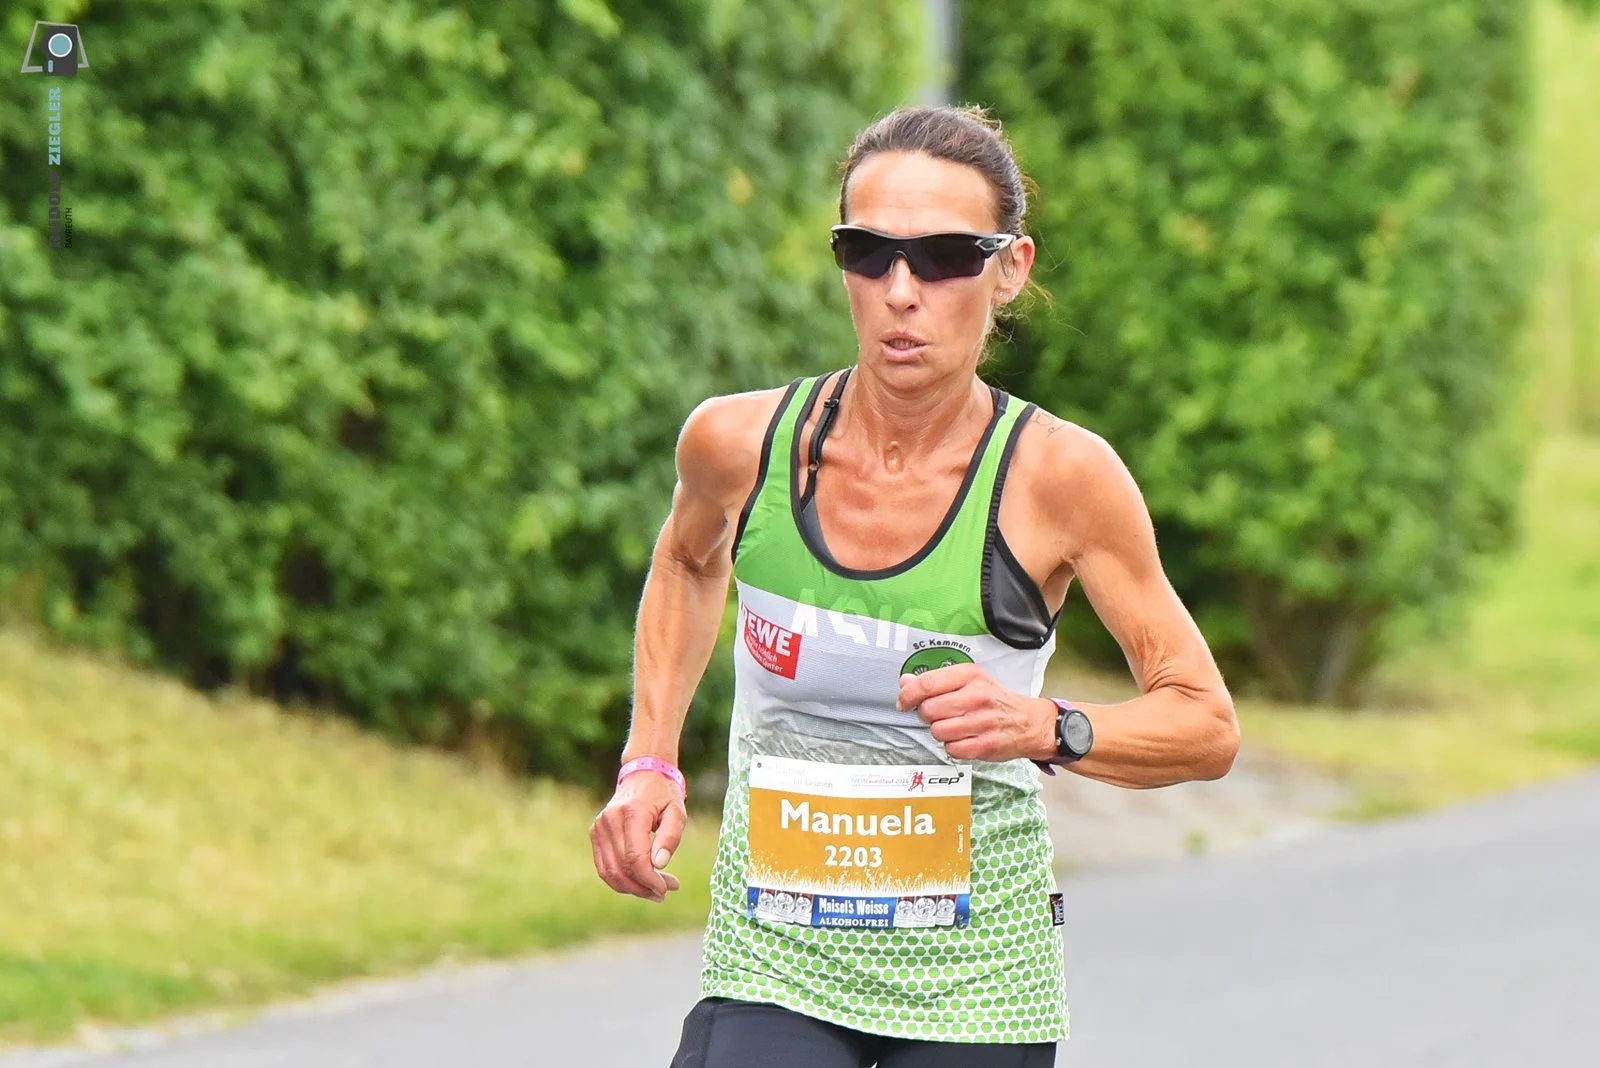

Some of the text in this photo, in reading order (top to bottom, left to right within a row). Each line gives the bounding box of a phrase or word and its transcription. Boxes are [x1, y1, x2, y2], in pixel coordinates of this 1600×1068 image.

[912, 638, 972, 654] SC Kemmern
[762, 657, 784, 673] Center
[928, 775, 960, 785] cep
[780, 798, 936, 836] Manuela
[824, 844, 883, 868] 2203
[818, 896, 855, 915] Maisel's
[856, 899, 889, 916] Weisse
[819, 916, 889, 928] ALKOHOLFREI
